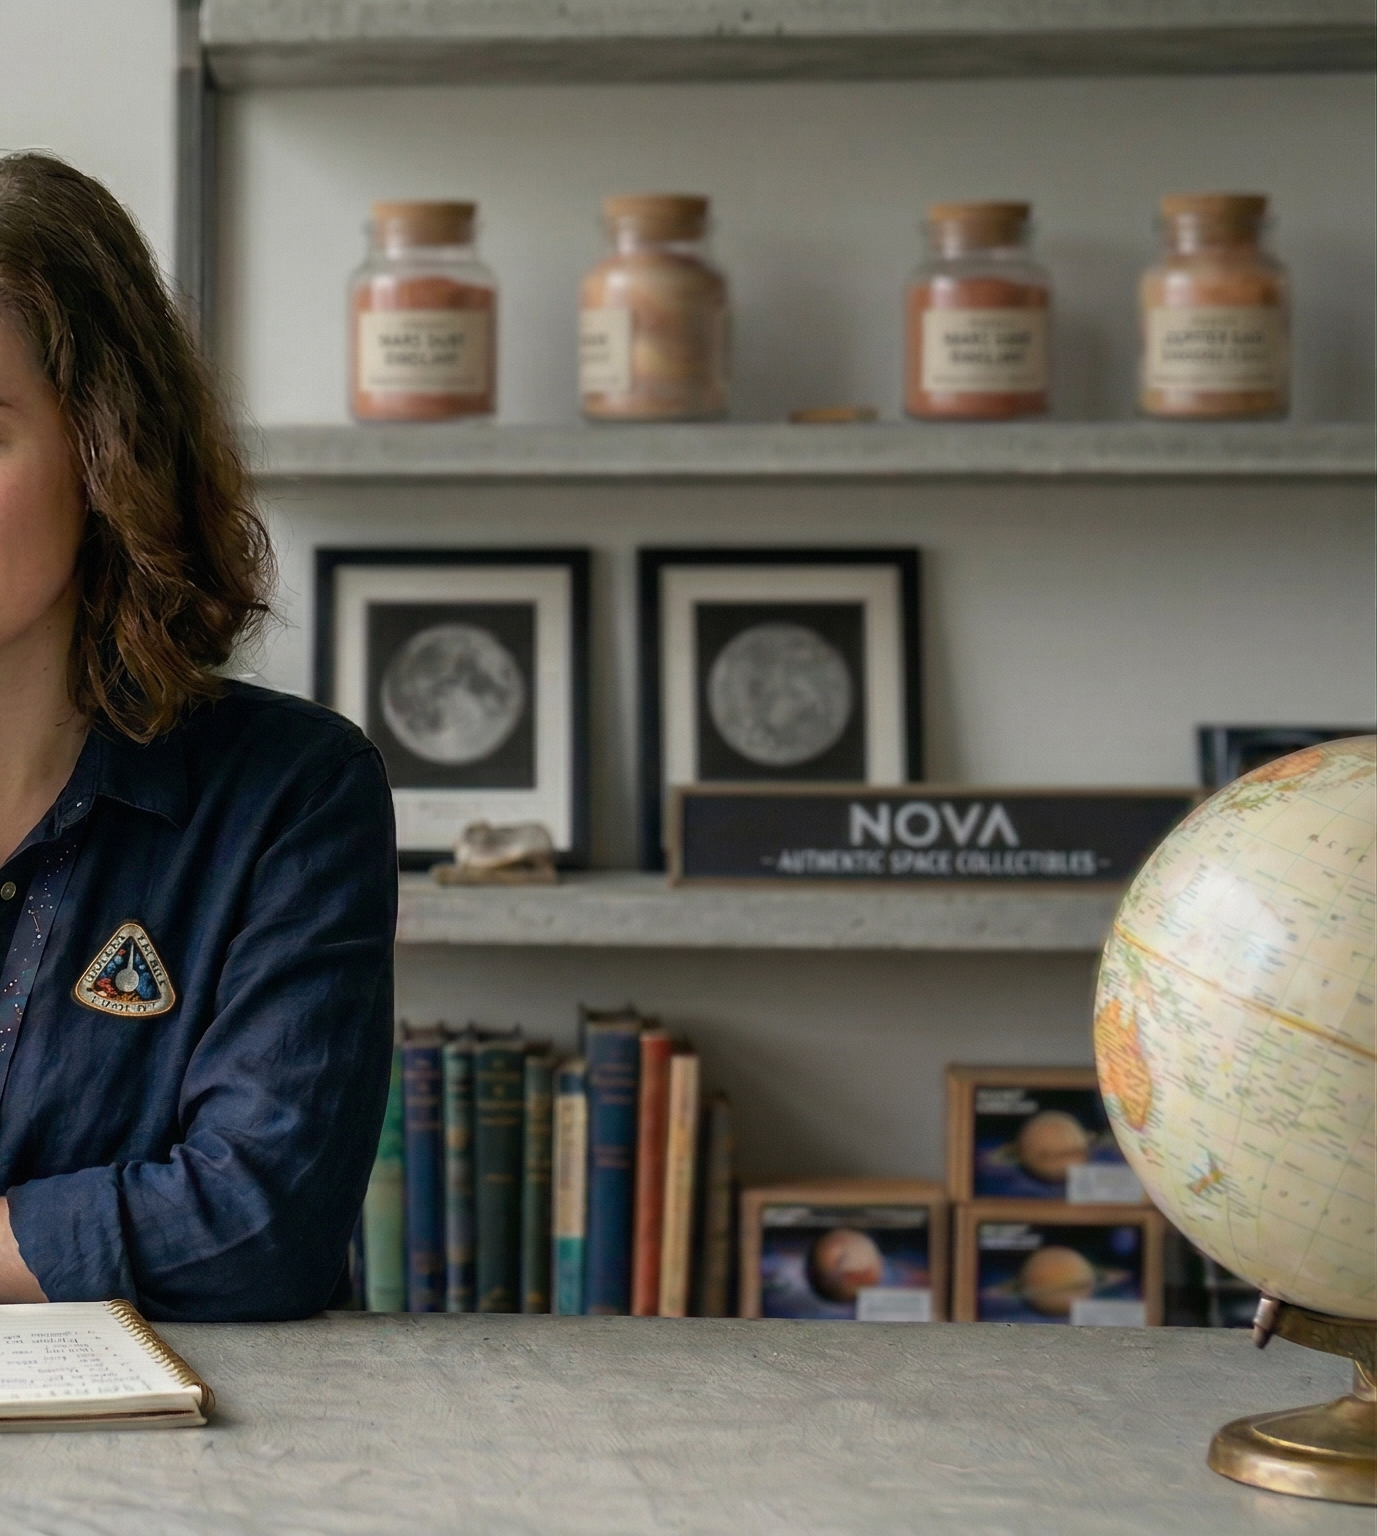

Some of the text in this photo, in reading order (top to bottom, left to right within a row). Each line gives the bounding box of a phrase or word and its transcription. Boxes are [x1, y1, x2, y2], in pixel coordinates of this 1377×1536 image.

[849, 801, 1020, 848] NOVA
[777, 848, 1097, 875] AUTHENTIC SPACE COLLECTIBLES
